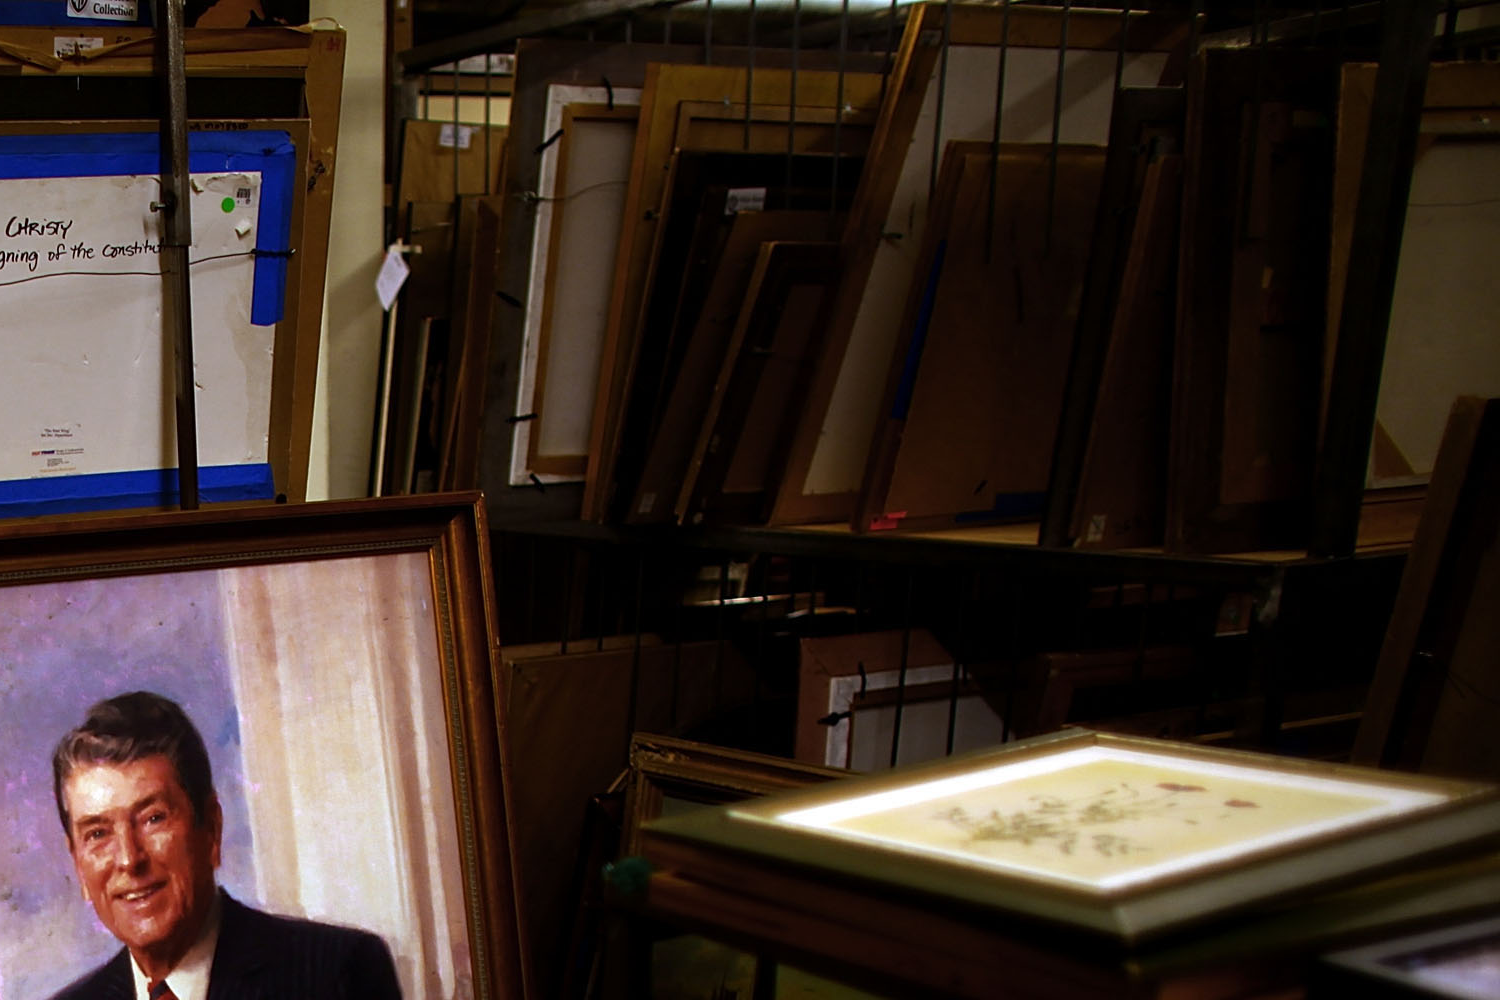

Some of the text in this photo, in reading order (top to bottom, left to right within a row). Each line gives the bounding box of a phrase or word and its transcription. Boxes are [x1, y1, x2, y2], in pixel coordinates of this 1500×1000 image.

[93, 3, 134, 16] Collection
[48, 243, 67, 261] of
[70, 242, 94, 259] the
